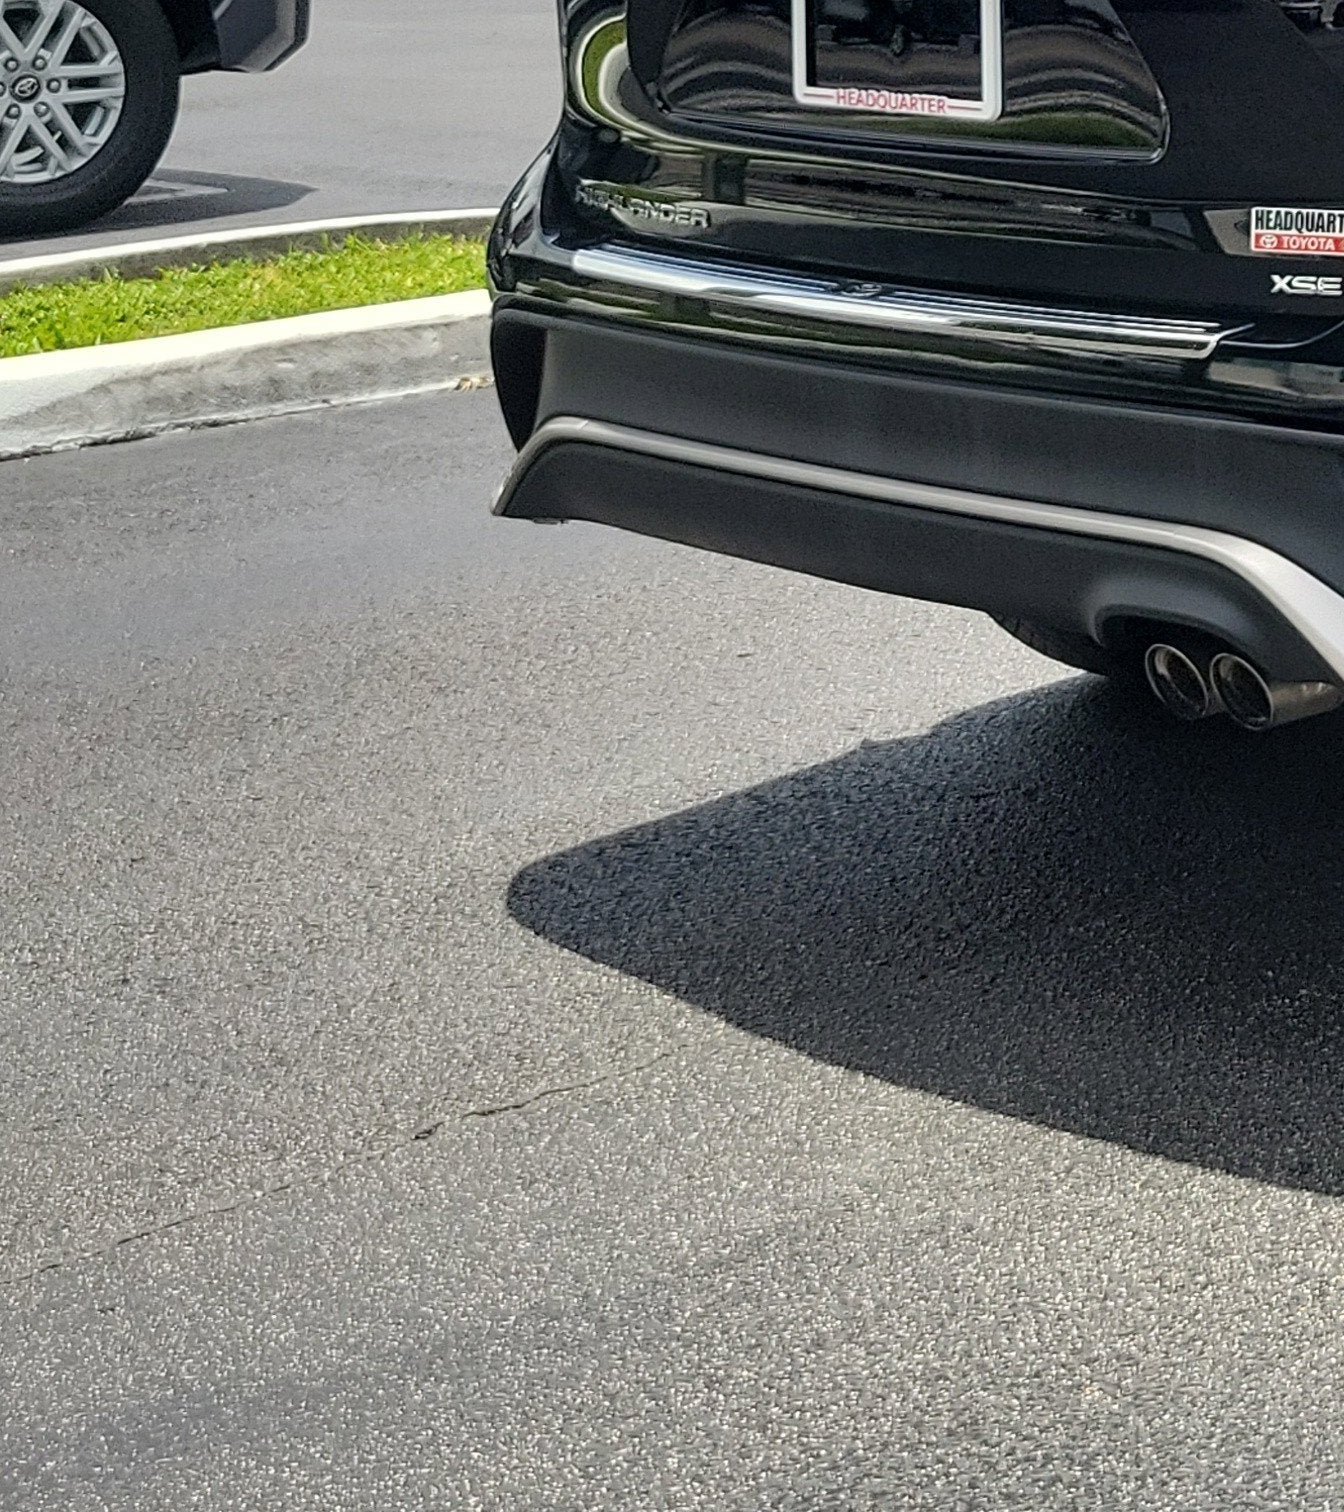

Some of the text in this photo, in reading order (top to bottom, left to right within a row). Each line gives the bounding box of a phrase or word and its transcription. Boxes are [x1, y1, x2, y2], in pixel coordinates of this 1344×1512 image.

[836, 90, 947, 114] HEADQUARTER
[1281, 235, 1336, 251] TOYOTA
[1269, 274, 1343, 296] XSE
